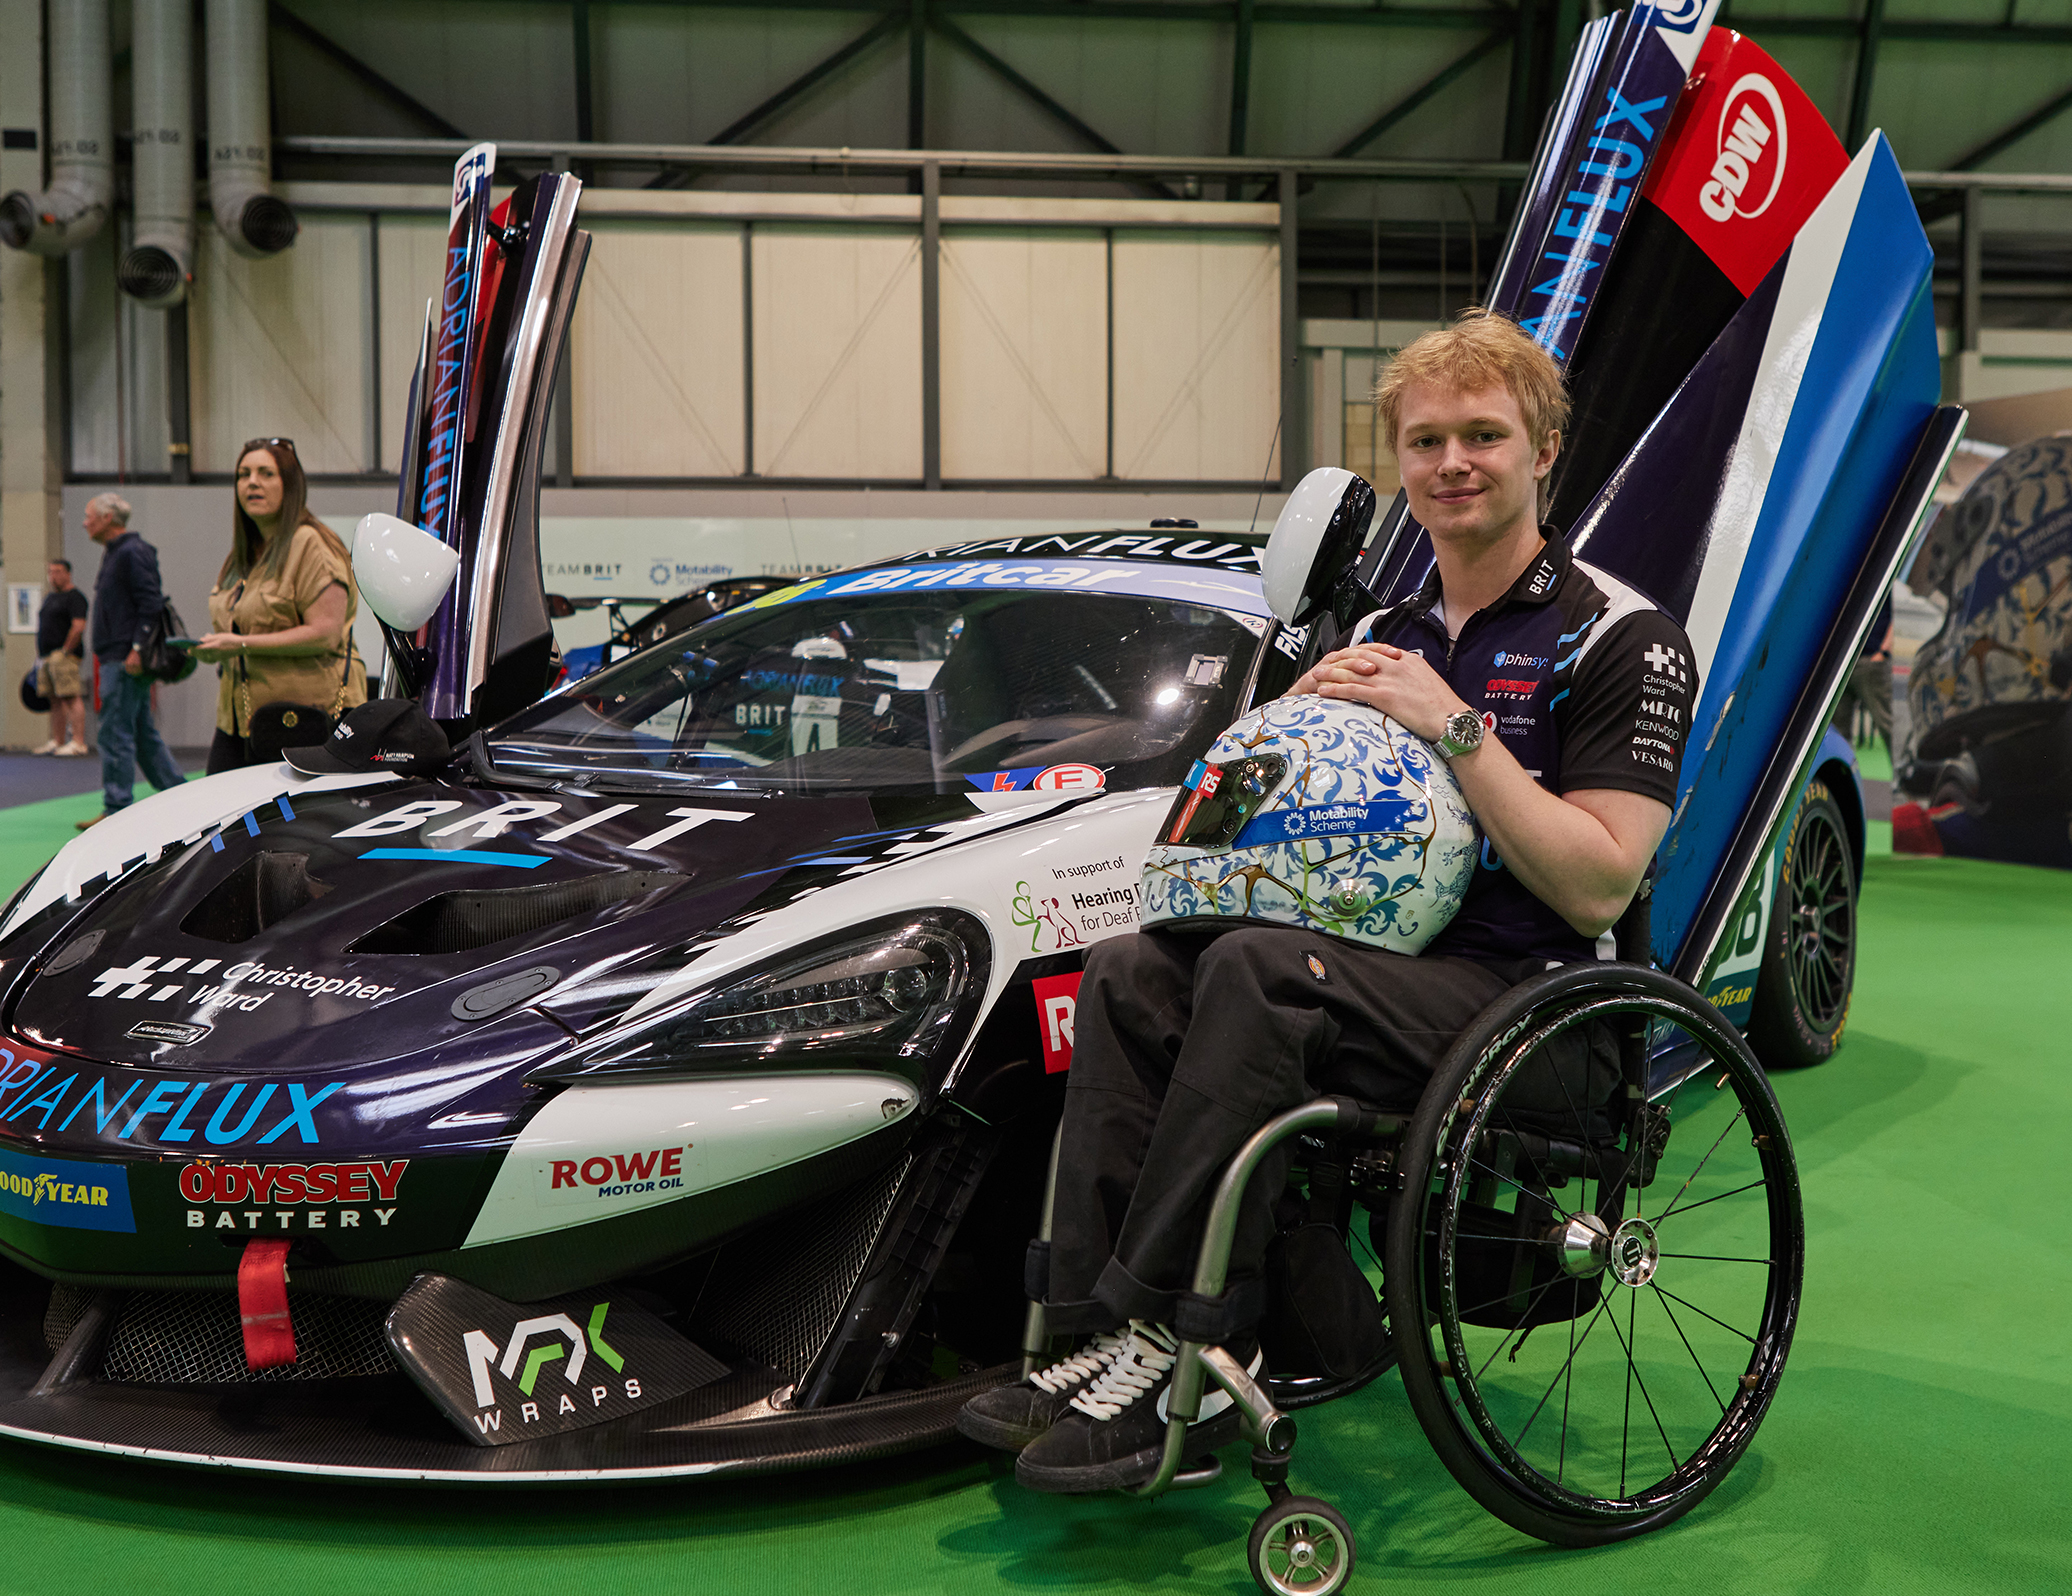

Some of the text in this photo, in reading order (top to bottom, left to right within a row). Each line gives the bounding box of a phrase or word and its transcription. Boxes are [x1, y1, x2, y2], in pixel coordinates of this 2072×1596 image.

[1699, 102, 1772, 223] CDW
[1519, 86, 1668, 360] ANFLUX
[675, 564, 734, 577] Motability
[826, 562, 1142, 596] Britcar
[1528, 559, 1553, 595] BRIT
[1484, 692, 1533, 701] BATTERY
[1642, 684, 1666, 697] Ward
[1643, 674, 1686, 695] Christopher
[735, 703, 786, 726] BRIT
[1501, 715, 1536, 726] vodafone
[1637, 699, 1683, 725] MRTC
[1500, 726, 1528, 736] business
[1635, 719, 1680, 741] KENWOOD
[1632, 736, 1671, 753] DAYTONA
[1631, 750, 1674, 773] VESARO
[1200, 771, 1221, 794] RS
[331, 800, 756, 851] BRIT
[1309, 806, 1370, 821] Motability
[1310, 820, 1356, 833] Scheme
[1052, 855, 1125, 880] In support of
[1071, 887, 1135, 910] Hearing
[1080, 914, 1100, 931] for
[1102, 906, 1134, 927] Deaf
[222, 961, 396, 1001] Christopher
[187, 984, 275, 1012] Ward
[1045, 995, 1076, 1052] R
[0, 1048, 347, 1145] RIANFLUX
[548, 1147, 684, 1190] ROWE
[0, 1170, 109, 1206] OODYEAR
[179, 1160, 409, 1204] ODYSSEY
[598, 1177, 684, 1197] MOTOR OIL
[187, 1208, 397, 1229] BATTERY
[473, 1378, 642, 1434] WRAPS
